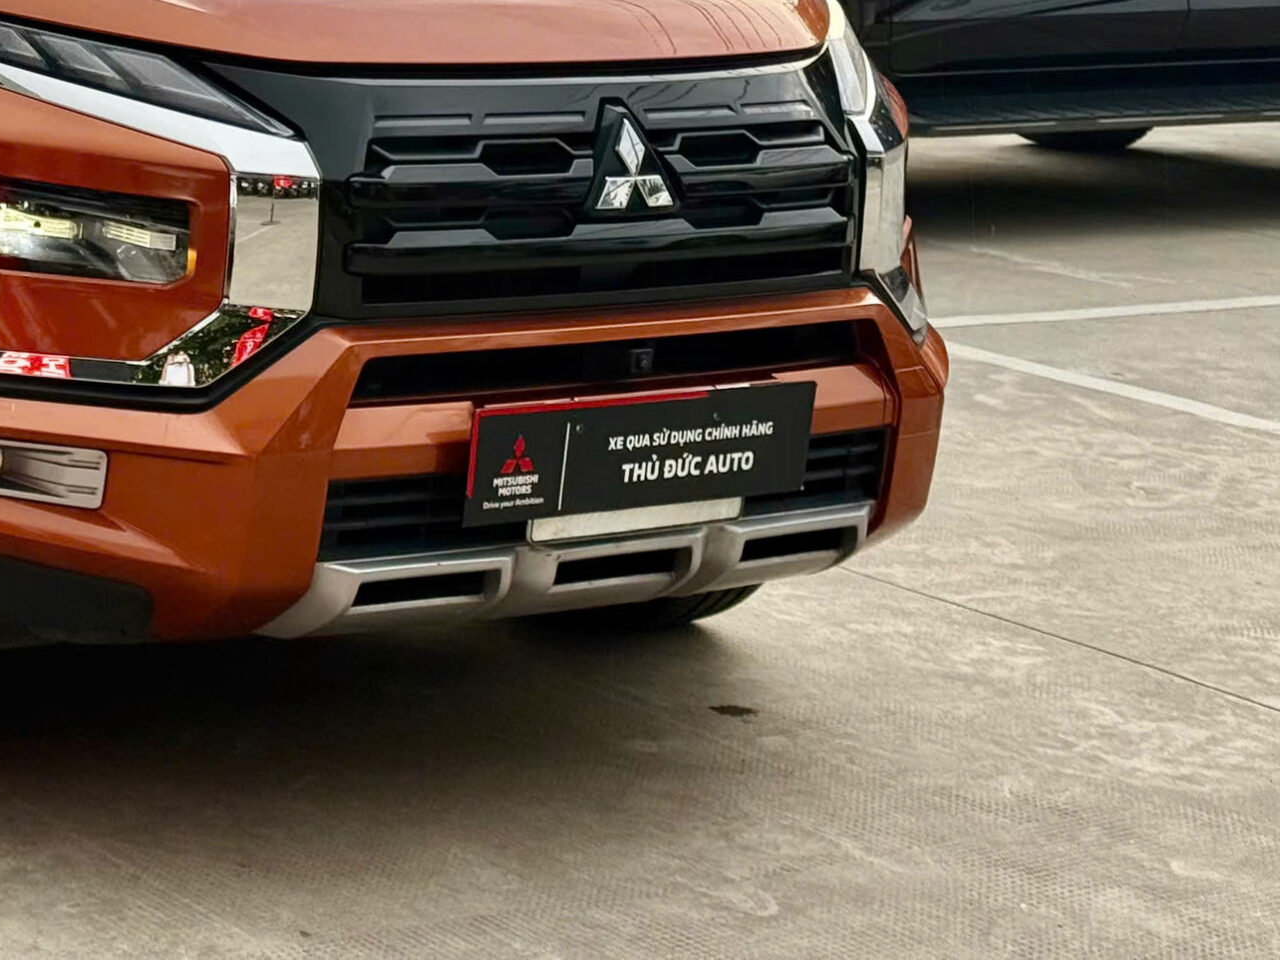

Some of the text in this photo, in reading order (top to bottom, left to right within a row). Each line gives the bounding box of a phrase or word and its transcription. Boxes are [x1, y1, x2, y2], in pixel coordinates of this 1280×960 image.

[608, 421, 773, 452] XE QUA SỬ DỤNG CHÍNH HÃNG
[622, 451, 754, 483] THỦ ĐỨC AUTO
[493, 473, 539, 488] MITSUBISHI
[498, 484, 532, 497] MOTORS
[483, 496, 544, 511] Drive your Ambition
